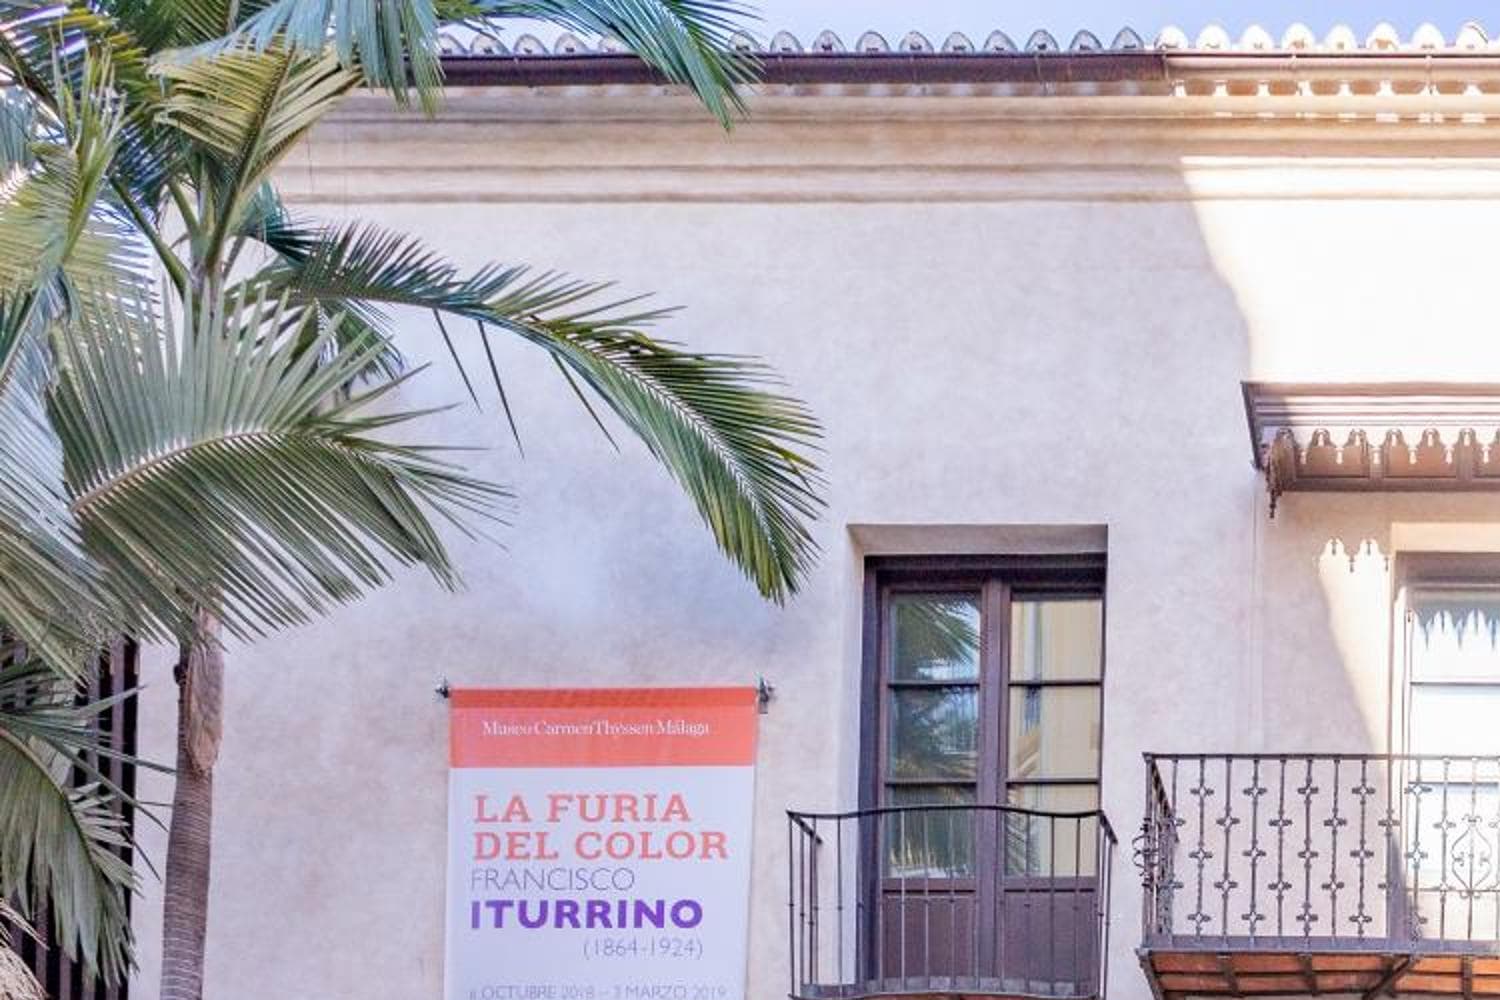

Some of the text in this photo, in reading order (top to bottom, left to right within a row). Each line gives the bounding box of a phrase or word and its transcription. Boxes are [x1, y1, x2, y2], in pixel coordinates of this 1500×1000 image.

[536, 719, 592, 736] Carmen
[593, 719, 653, 739] Thyssen
[473, 792, 693, 824] LA FURIA
[473, 829, 729, 861] DEL COLOR
[470, 866, 636, 892] FRANCISCO
[470, 899, 704, 930] ITURRINO
[582, 937, 704, 961] (1864-1924)
[481, 985, 557, 1000] OCTUBRE
[624, 983, 688, 1000] MARZO
